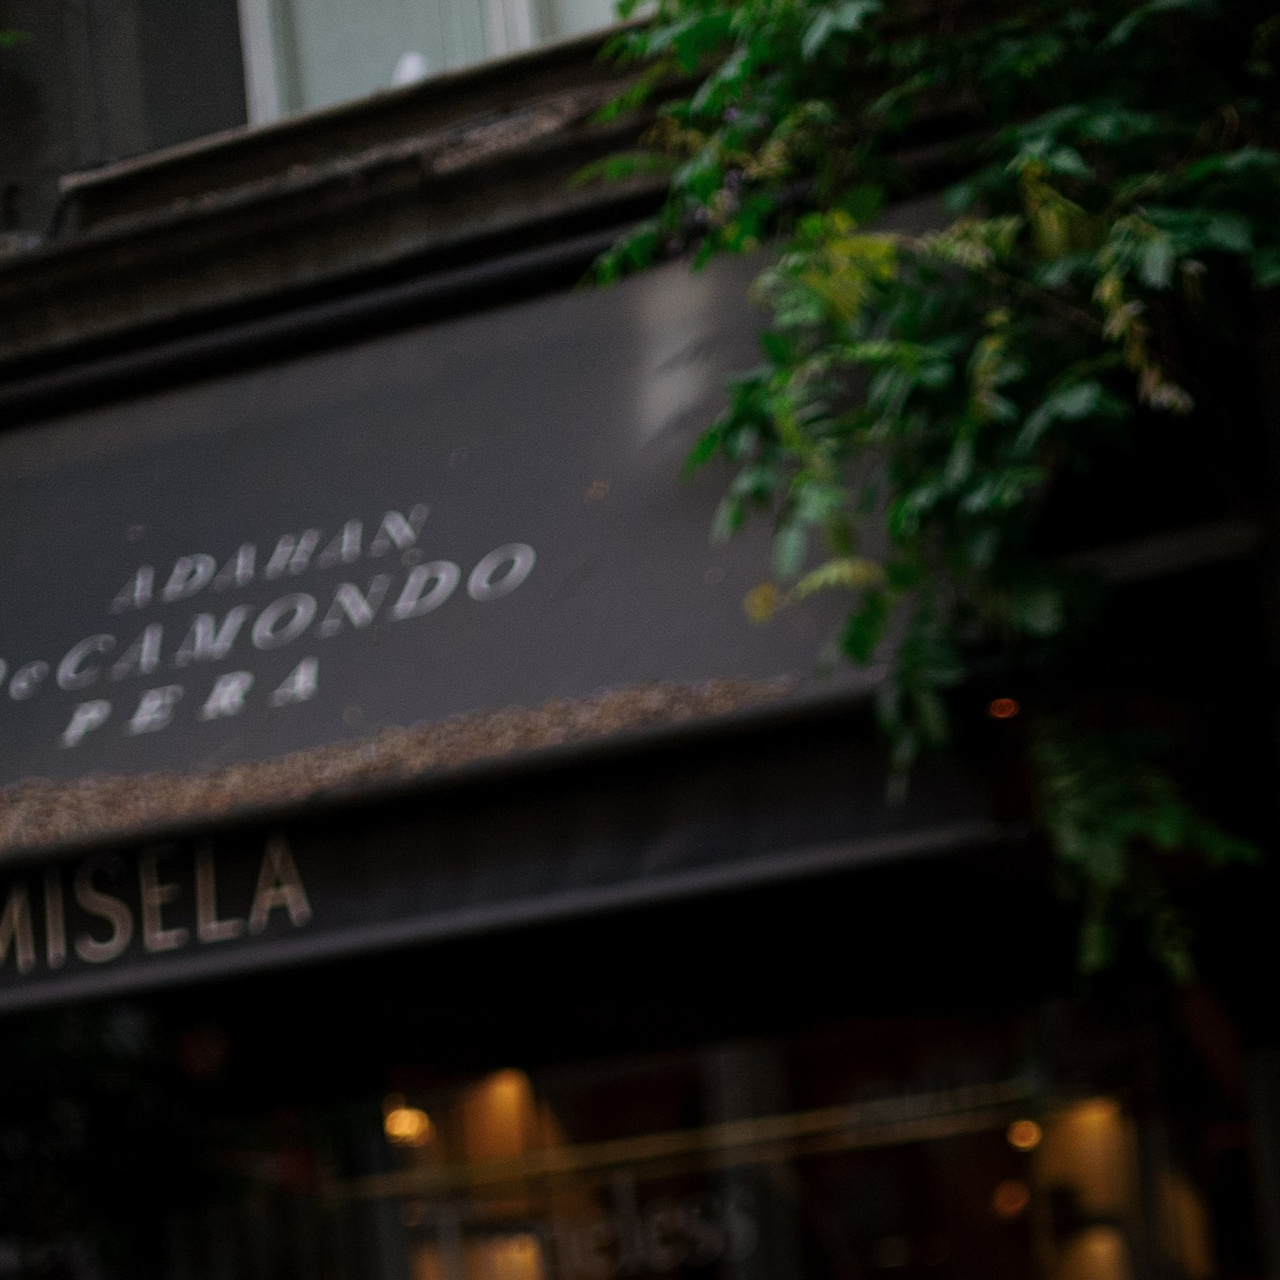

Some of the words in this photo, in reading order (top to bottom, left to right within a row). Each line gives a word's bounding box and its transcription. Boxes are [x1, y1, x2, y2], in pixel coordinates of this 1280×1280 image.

[110, 503, 430, 614] ADAHAN
[0, 542, 537, 701] eCAMONDO
[59, 656, 320, 749] PERA
